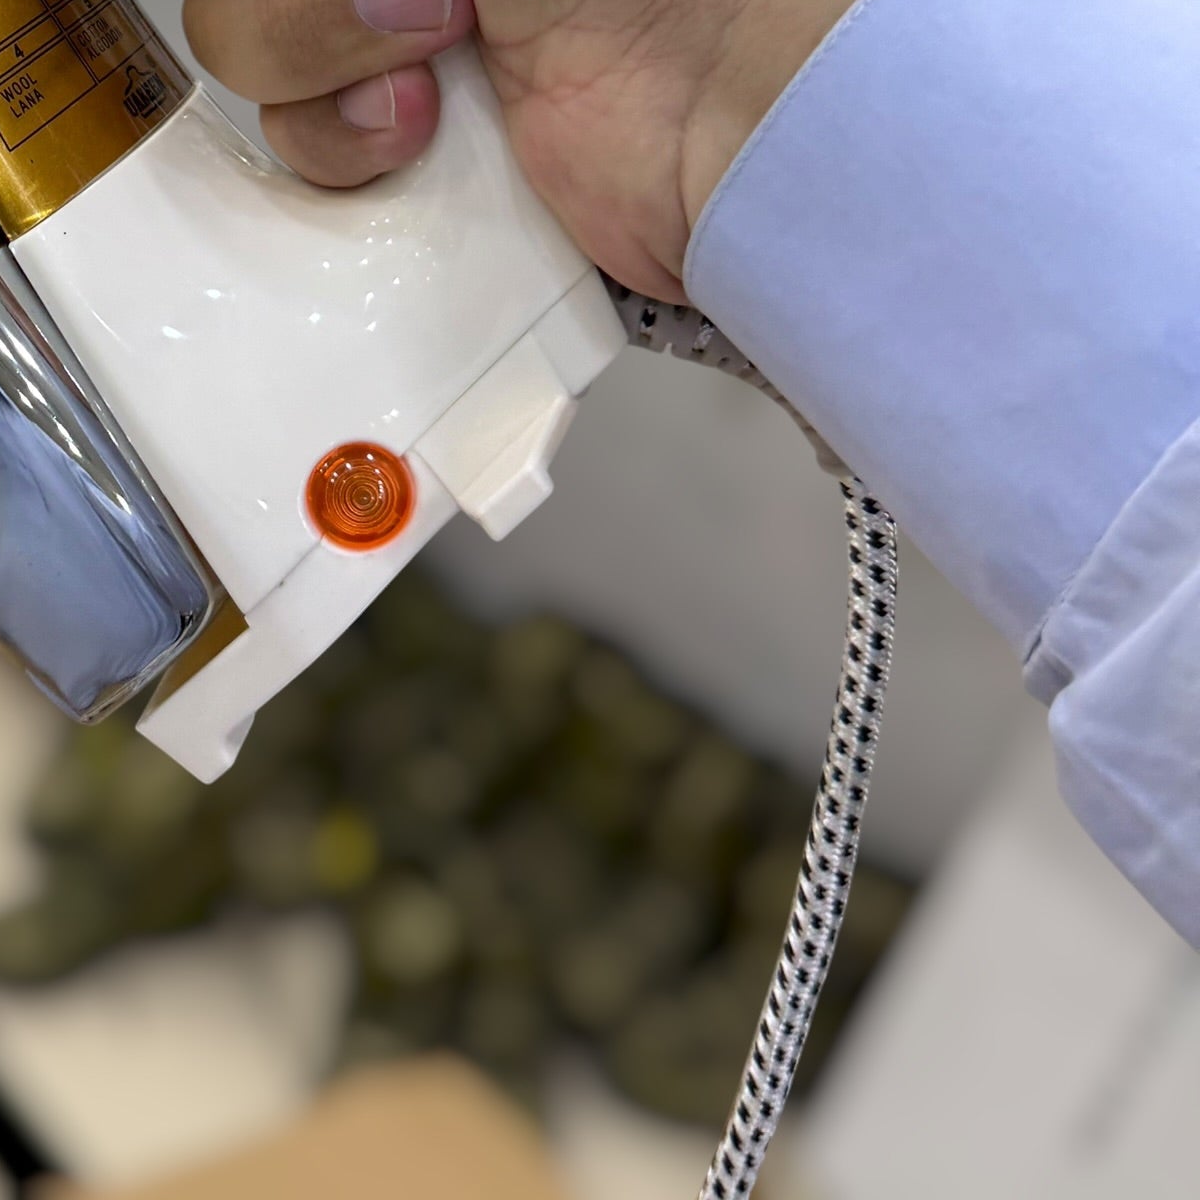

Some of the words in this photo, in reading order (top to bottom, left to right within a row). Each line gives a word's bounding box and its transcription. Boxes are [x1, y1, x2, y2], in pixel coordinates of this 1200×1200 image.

[77, 17, 109, 48] COTTON
[14, 43, 24, 58] 4
[0, 73, 38, 102] WOOL
[10, 89, 44, 118] LANA
